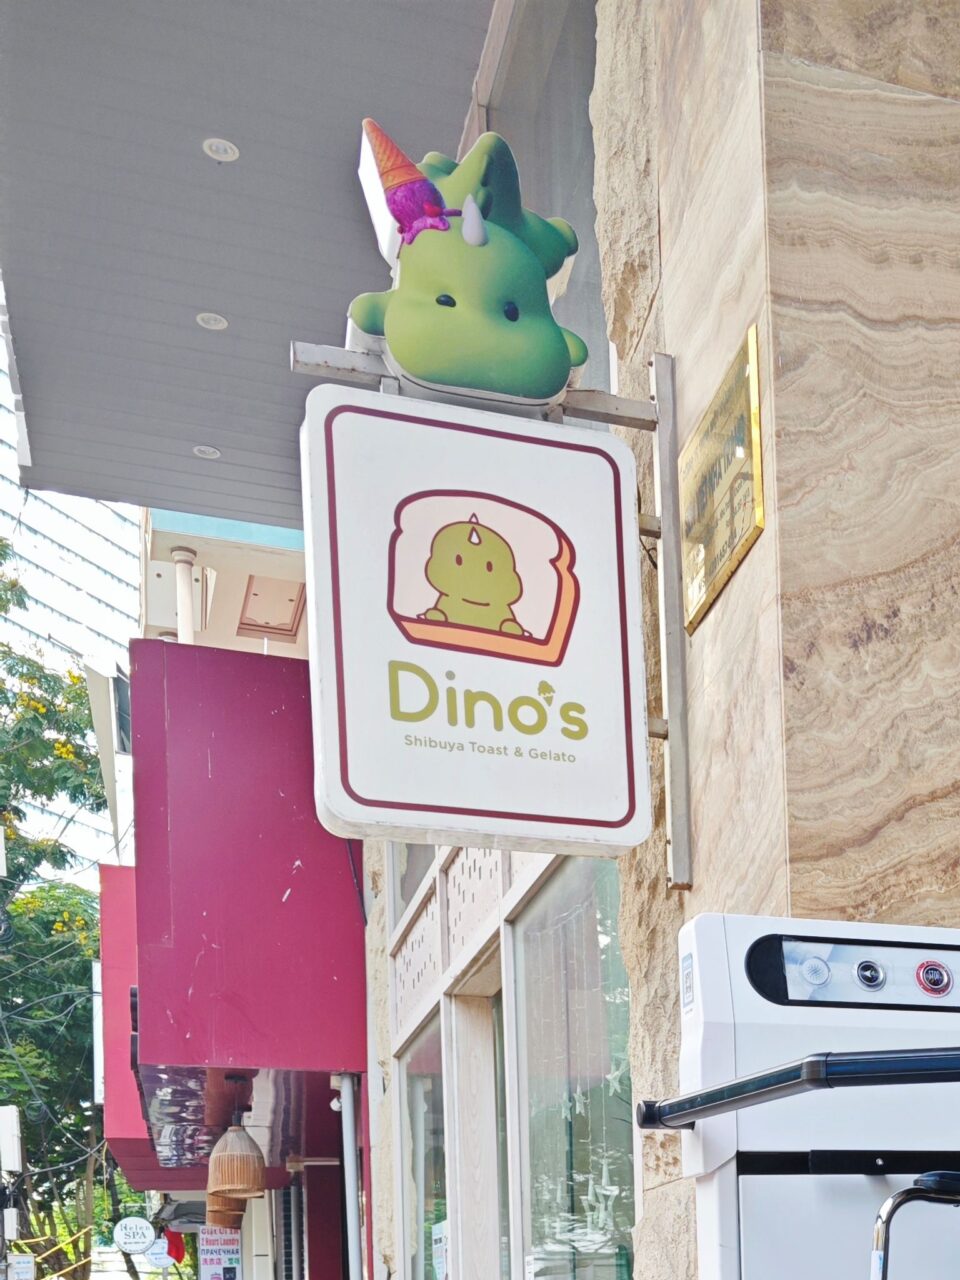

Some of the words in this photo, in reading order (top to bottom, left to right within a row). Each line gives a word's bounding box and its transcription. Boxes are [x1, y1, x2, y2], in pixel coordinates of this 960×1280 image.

[388, 660, 589, 741] Dino's
[404, 734, 465, 753] Shibuya
[468, 740, 509, 757] Toast
[513, 746, 524, 758] &
[528, 748, 577, 764] Gelato
[124, 1231, 147, 1240] SPA
